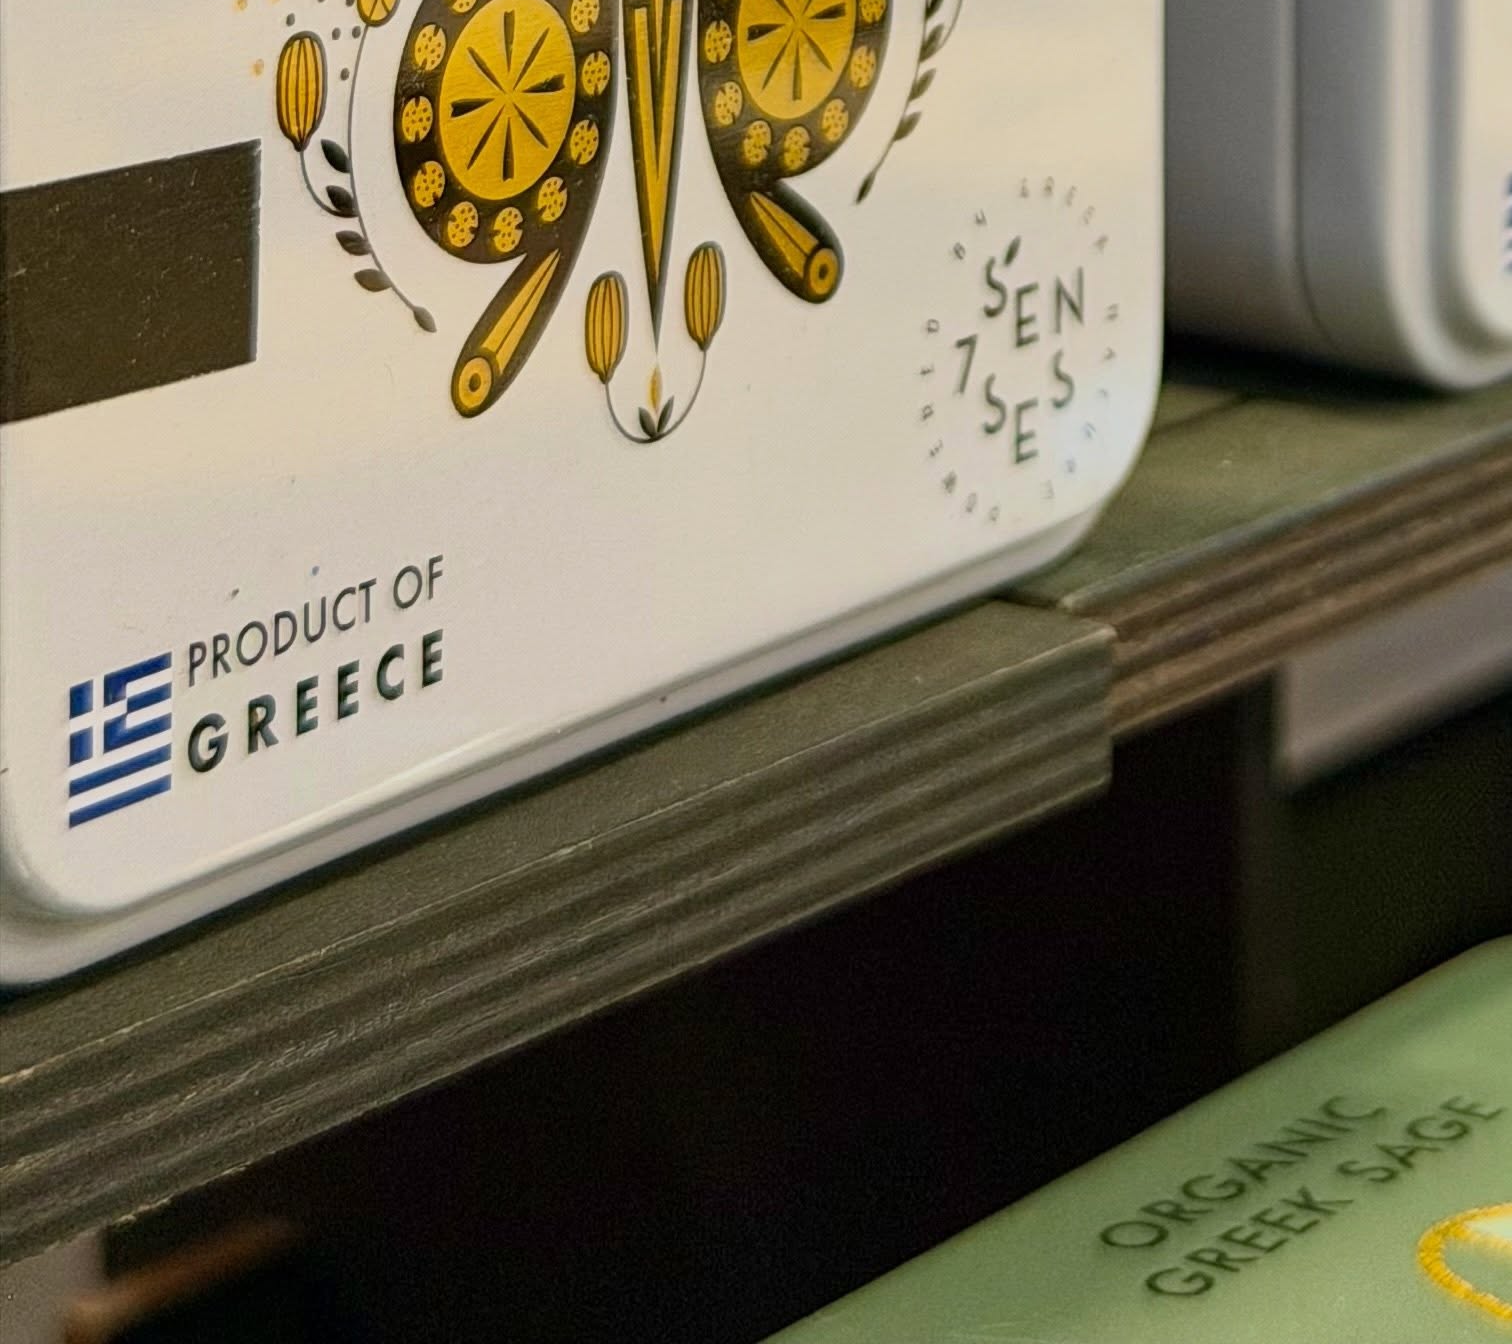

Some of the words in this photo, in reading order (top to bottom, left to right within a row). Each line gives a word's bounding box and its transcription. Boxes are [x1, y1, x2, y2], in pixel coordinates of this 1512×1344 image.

[188, 577, 378, 688] PRODUCT
[392, 554, 444, 610] OF
[187, 628, 444, 774] GREECE
[1100, 1095, 1387, 1249] ORGANIC
[1144, 1185, 1355, 1297] GREEK
[1336, 1095, 1508, 1184] SAGE
